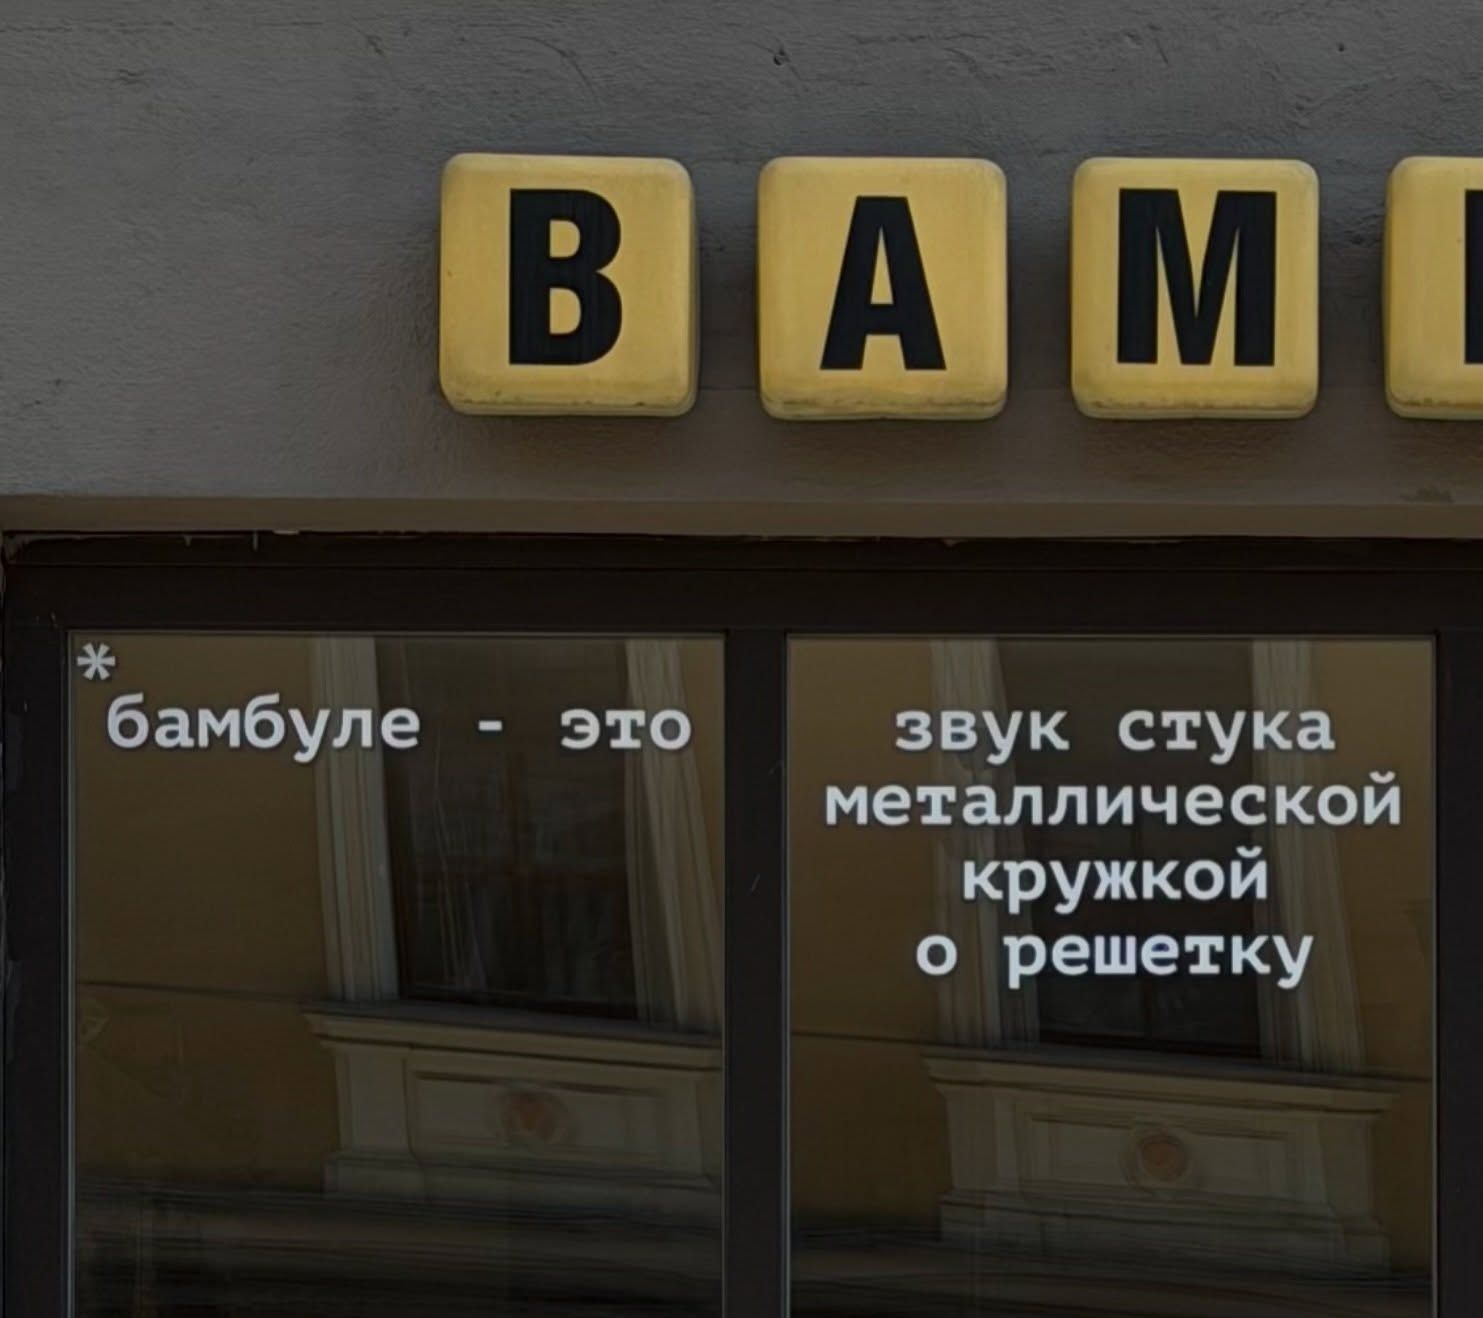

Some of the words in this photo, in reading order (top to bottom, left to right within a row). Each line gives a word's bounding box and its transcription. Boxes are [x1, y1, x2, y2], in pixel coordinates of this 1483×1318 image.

[106, 693, 421, 763] бамбуле
[560, 708, 692, 751] это
[895, 710, 1069, 765] звук
[1118, 710, 1335, 765] стука
[825, 770, 1402, 826] металлической
[962, 846, 1268, 915] кружкой
[915, 934, 958, 976] о
[1003, 934, 1314, 990] решетку
